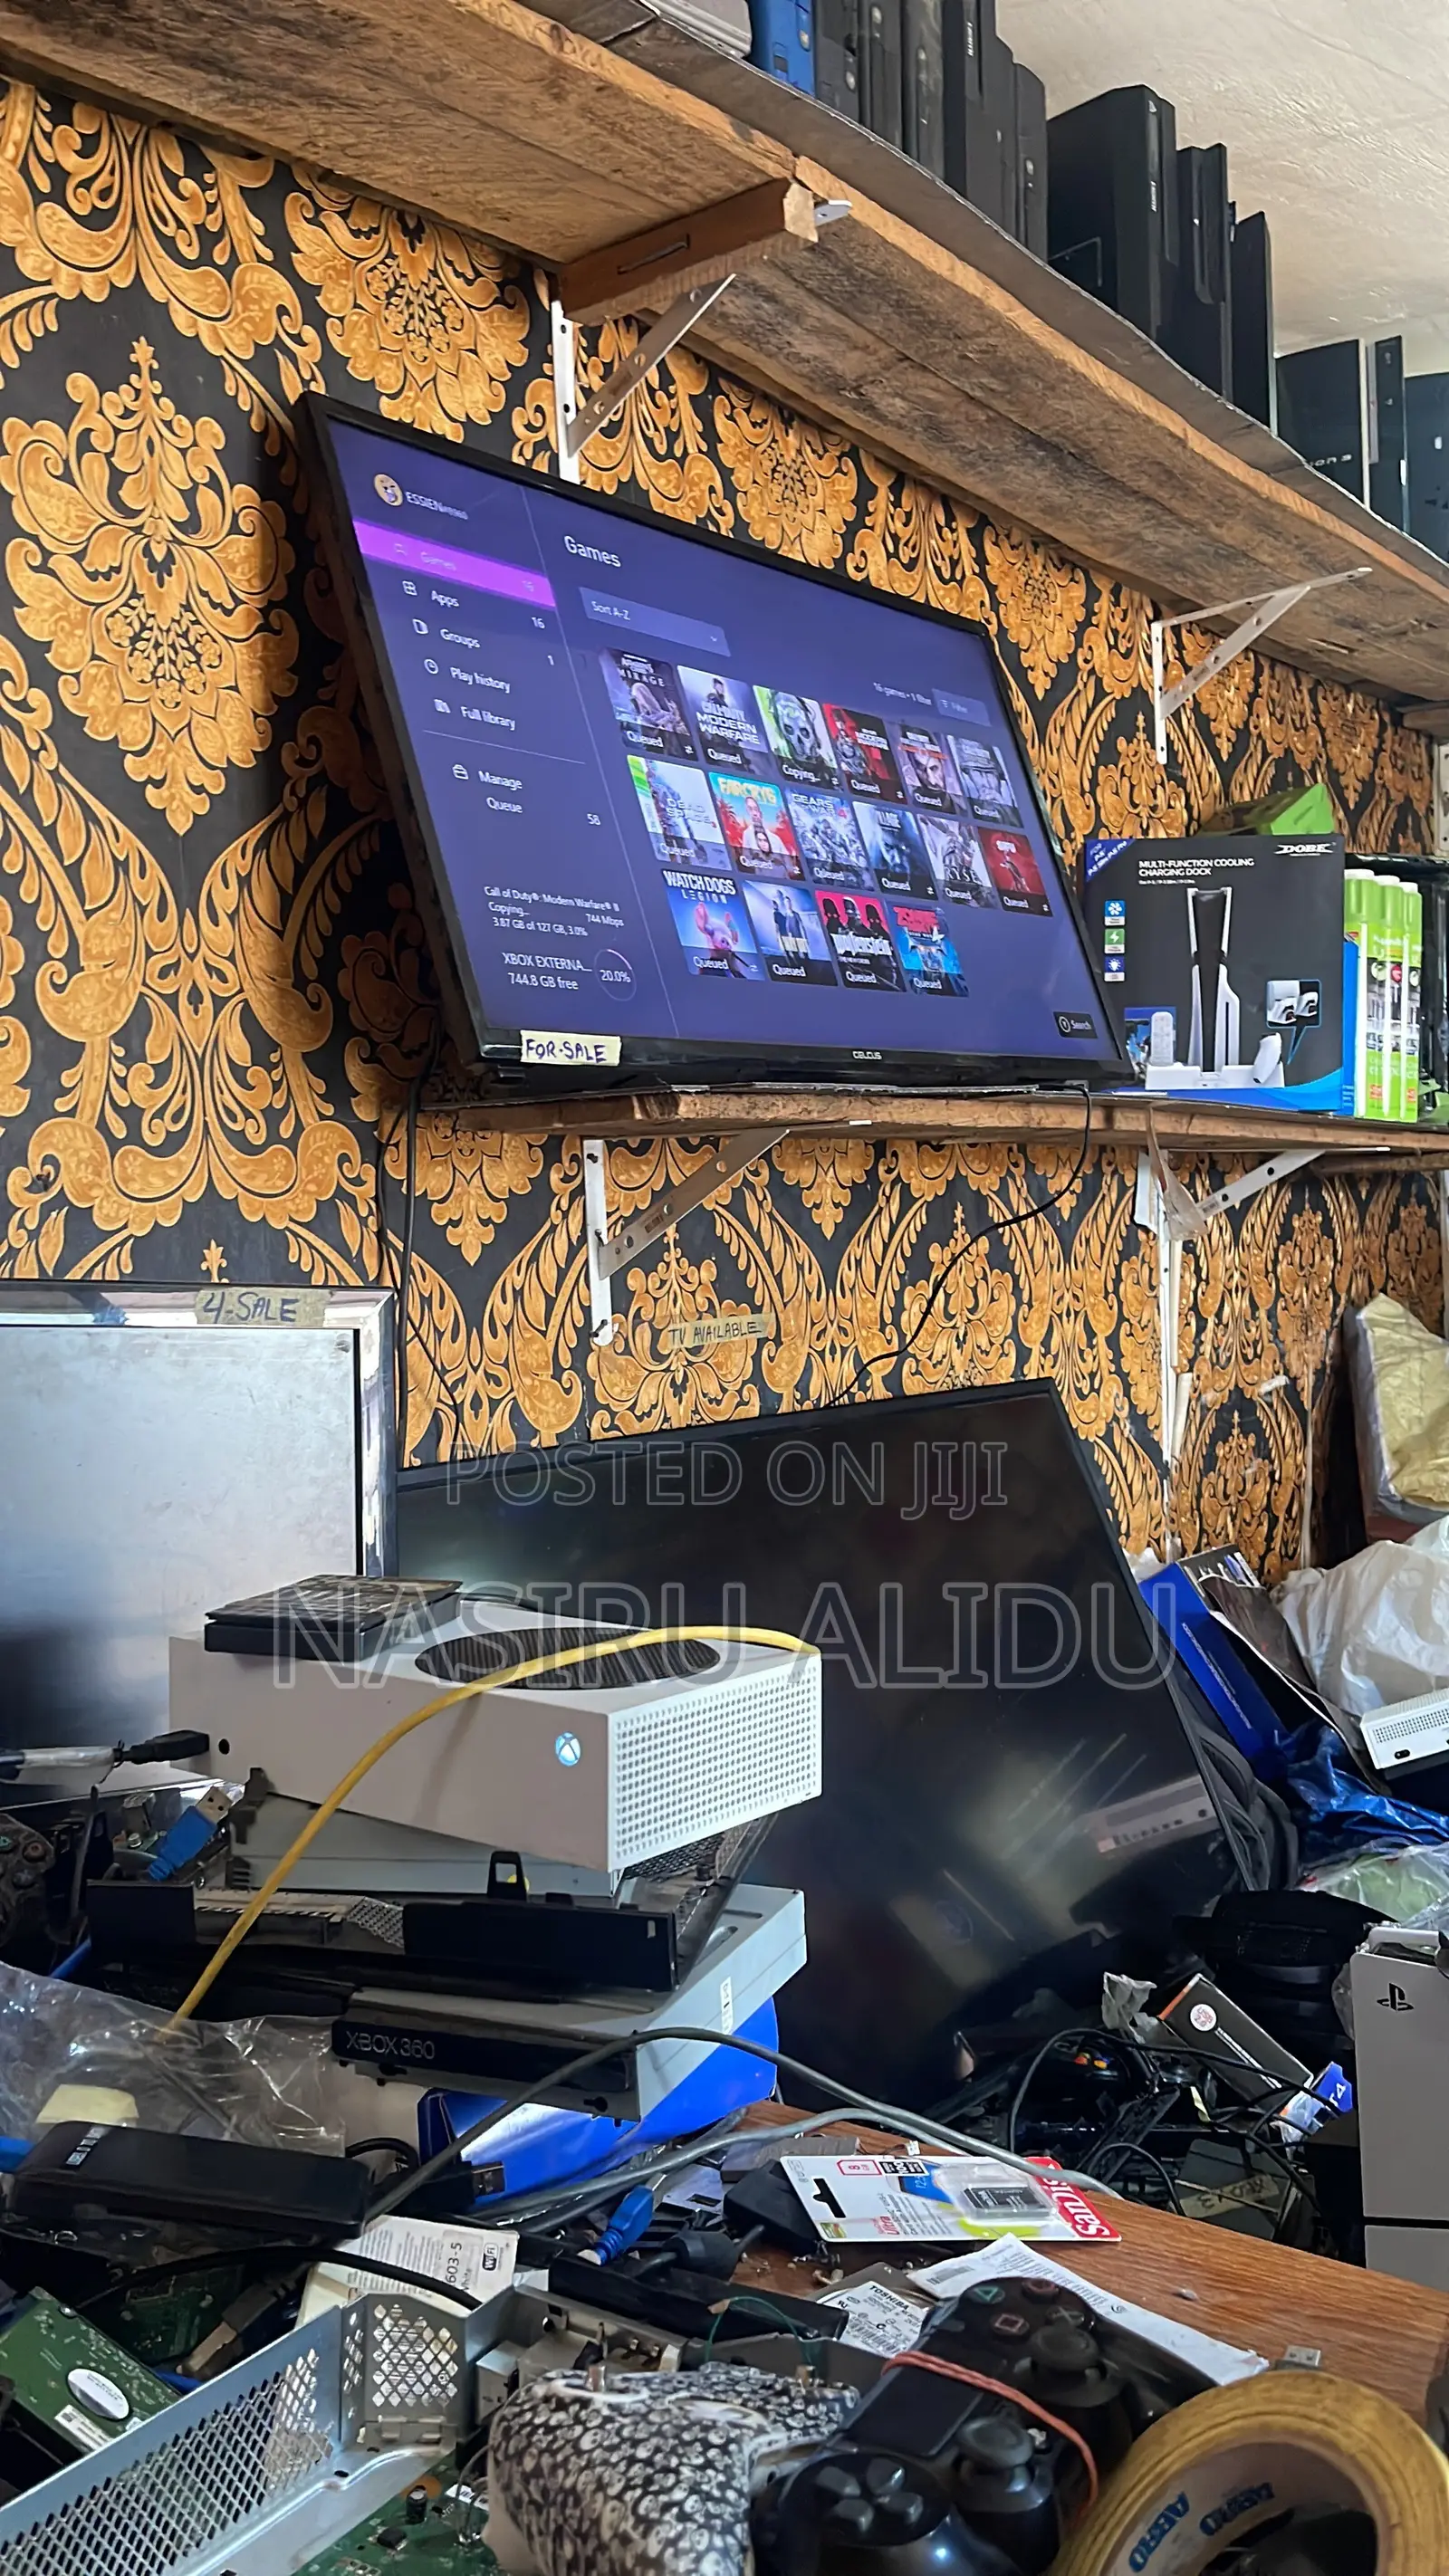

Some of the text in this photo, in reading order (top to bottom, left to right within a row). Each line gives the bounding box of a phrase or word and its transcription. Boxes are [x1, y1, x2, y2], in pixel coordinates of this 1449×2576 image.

[563, 535, 621, 568] Games
[429, 590, 545, 628] Apps 16
[591, 601, 630, 619] Sort A-Z
[439, 628, 554, 665] Groups 1
[450, 667, 512, 693] Play history
[884, 687, 906, 700] games
[461, 707, 517, 730] Full library
[696, 713, 756, 733] MODERN
[626, 730, 663, 747] Queued
[699, 723, 759, 743] WARFARE
[706, 748, 742, 763] Queued
[478, 771, 523, 791] Manage
[851, 780, 879, 792] Queued
[792, 794, 832, 807] GEARS
[915, 792, 941, 806] Queued
[486, 798, 600, 825] Queue 58
[1273, 843, 1333, 855] DOBE
[739, 856, 772, 869] Queued
[1138, 858, 1255, 869] MULTI-FUNCTION COOLING
[814, 867, 844, 880] Queued
[945, 867, 979, 882] RYSE
[1138, 868, 1185, 877] CHARGING
[664, 873, 736, 894] WATCH DOGS
[881, 877, 910, 890] Queued
[484, 886, 500, 896] Call
[502, 888, 512, 898] of
[543, 895, 573, 905] Modern
[682, 890, 726, 903] LEGION
[945, 886, 972, 900] Queued
[1003, 895, 1028, 908] Queued
[493, 917, 587, 935] 3.87 GB of 127 GB, 3.0%
[586, 914, 624, 927] 744 Mbps
[503, 953, 533, 965] XBOX
[693, 957, 728, 969] Queued
[600, 971, 630, 982] 20.0%
[772, 964, 805, 977] Queued
[846, 971, 876, 982] Queued
[508, 973, 578, 989] 744.8 GB free
[914, 977, 941, 988] Queued
[852, 1050, 882, 1060] CELCUS
[203, 1291, 299, 1324] 4-SALE
[667, 1322, 762, 1345] TV AVAILABLE
[1042, 2162, 1110, 2236] SanDis
[880, 2216, 900, 2236] Ultra
[868, 2284, 910, 2310] TOSHIBA
